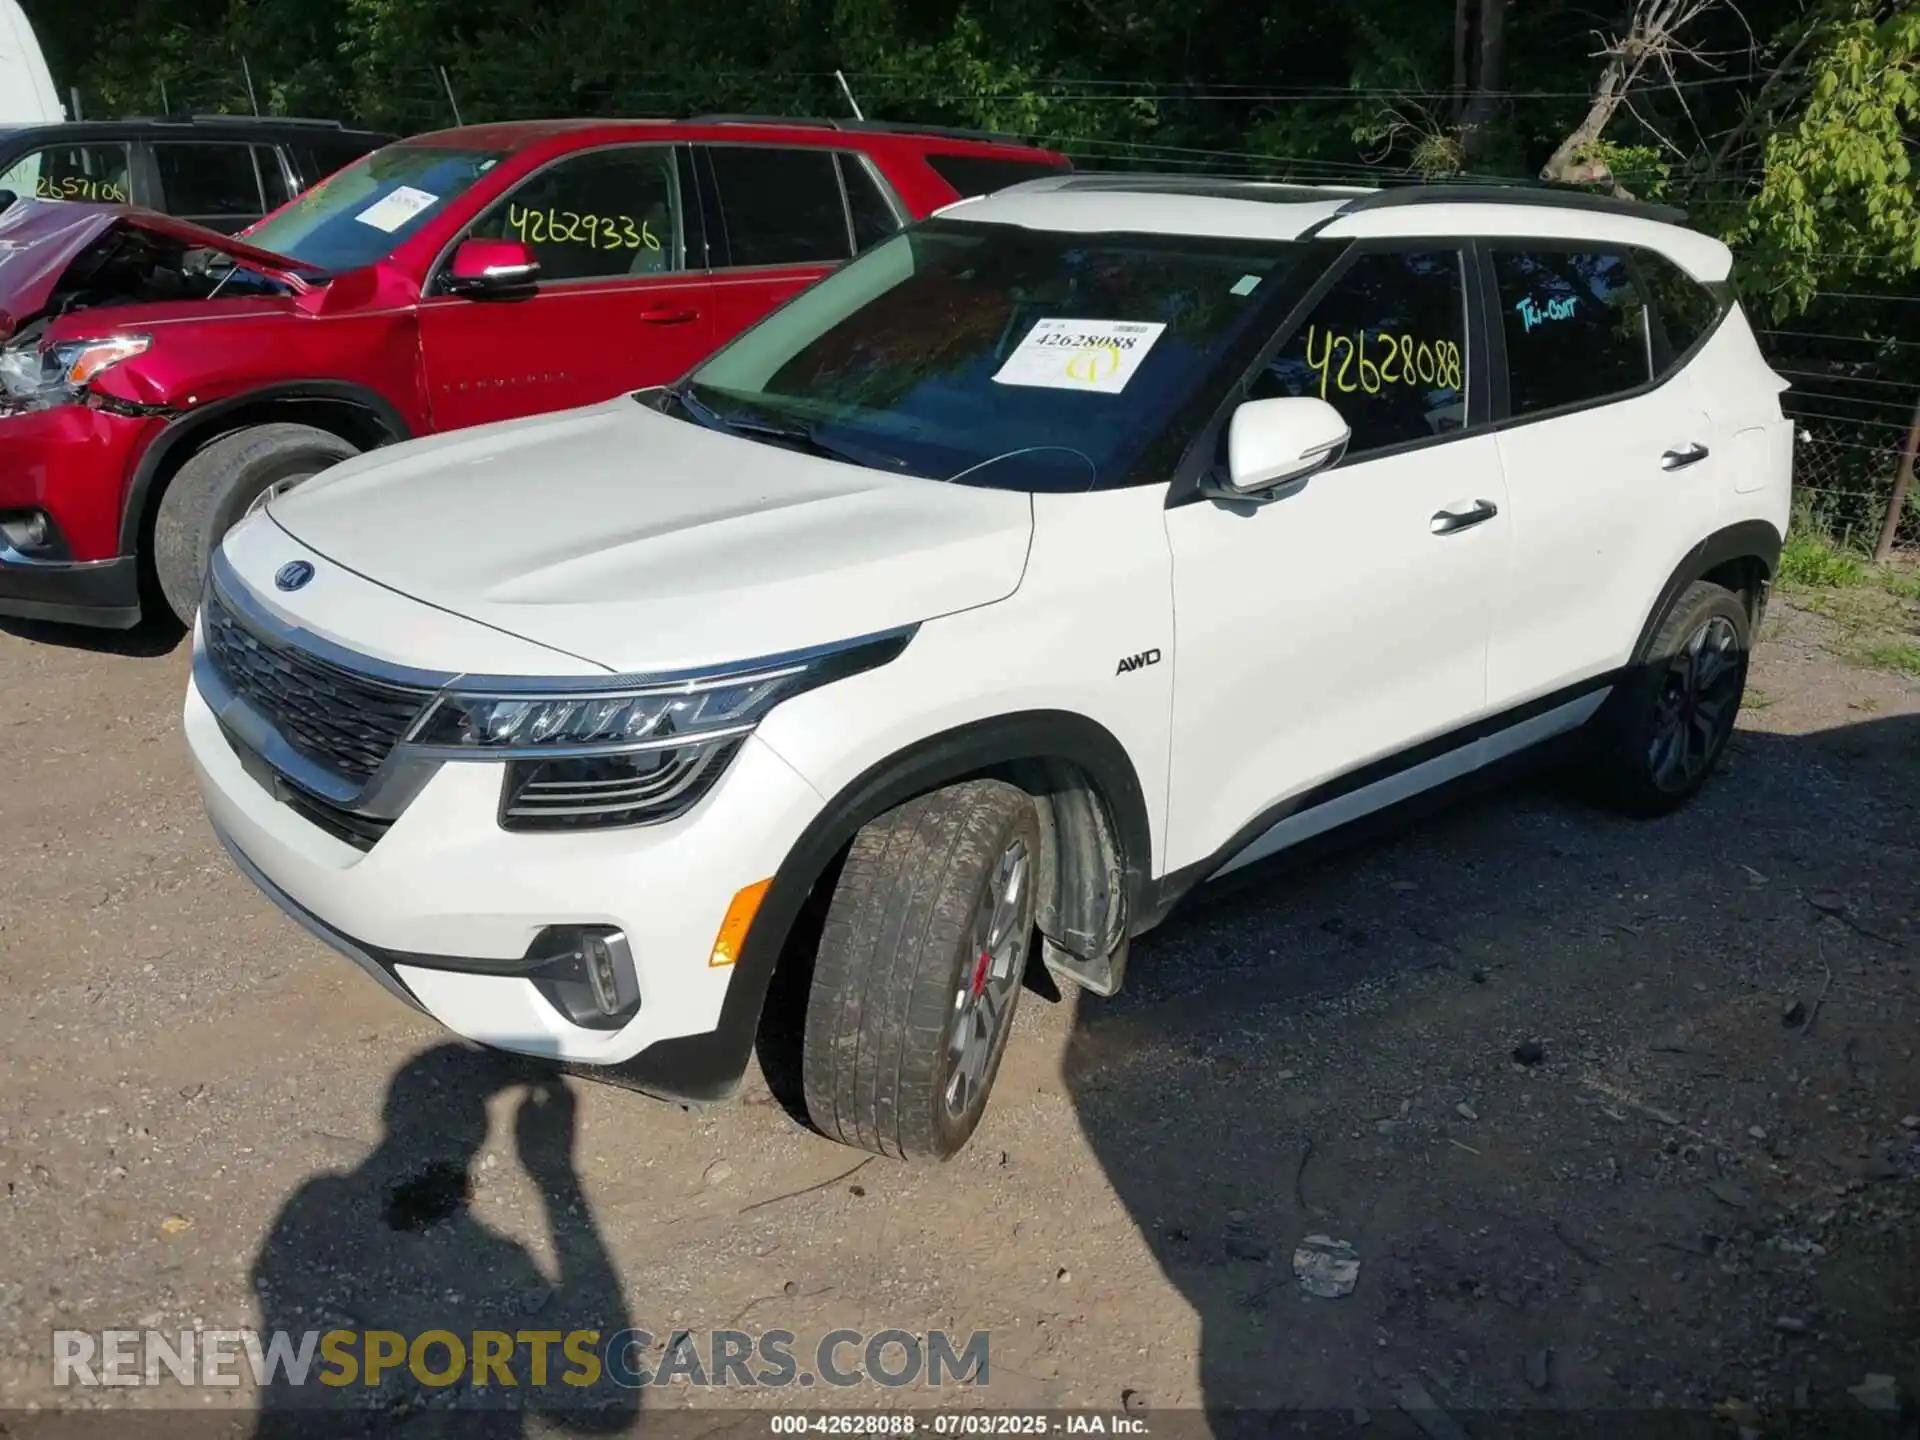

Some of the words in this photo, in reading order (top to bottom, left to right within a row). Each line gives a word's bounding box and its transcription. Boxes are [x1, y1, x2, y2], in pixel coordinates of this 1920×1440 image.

[509, 203, 661, 252] 42629336
[1035, 332, 1138, 350] 42628088
[1306, 324, 1461, 400] 42628088
[1115, 647, 1162, 677] AWD
